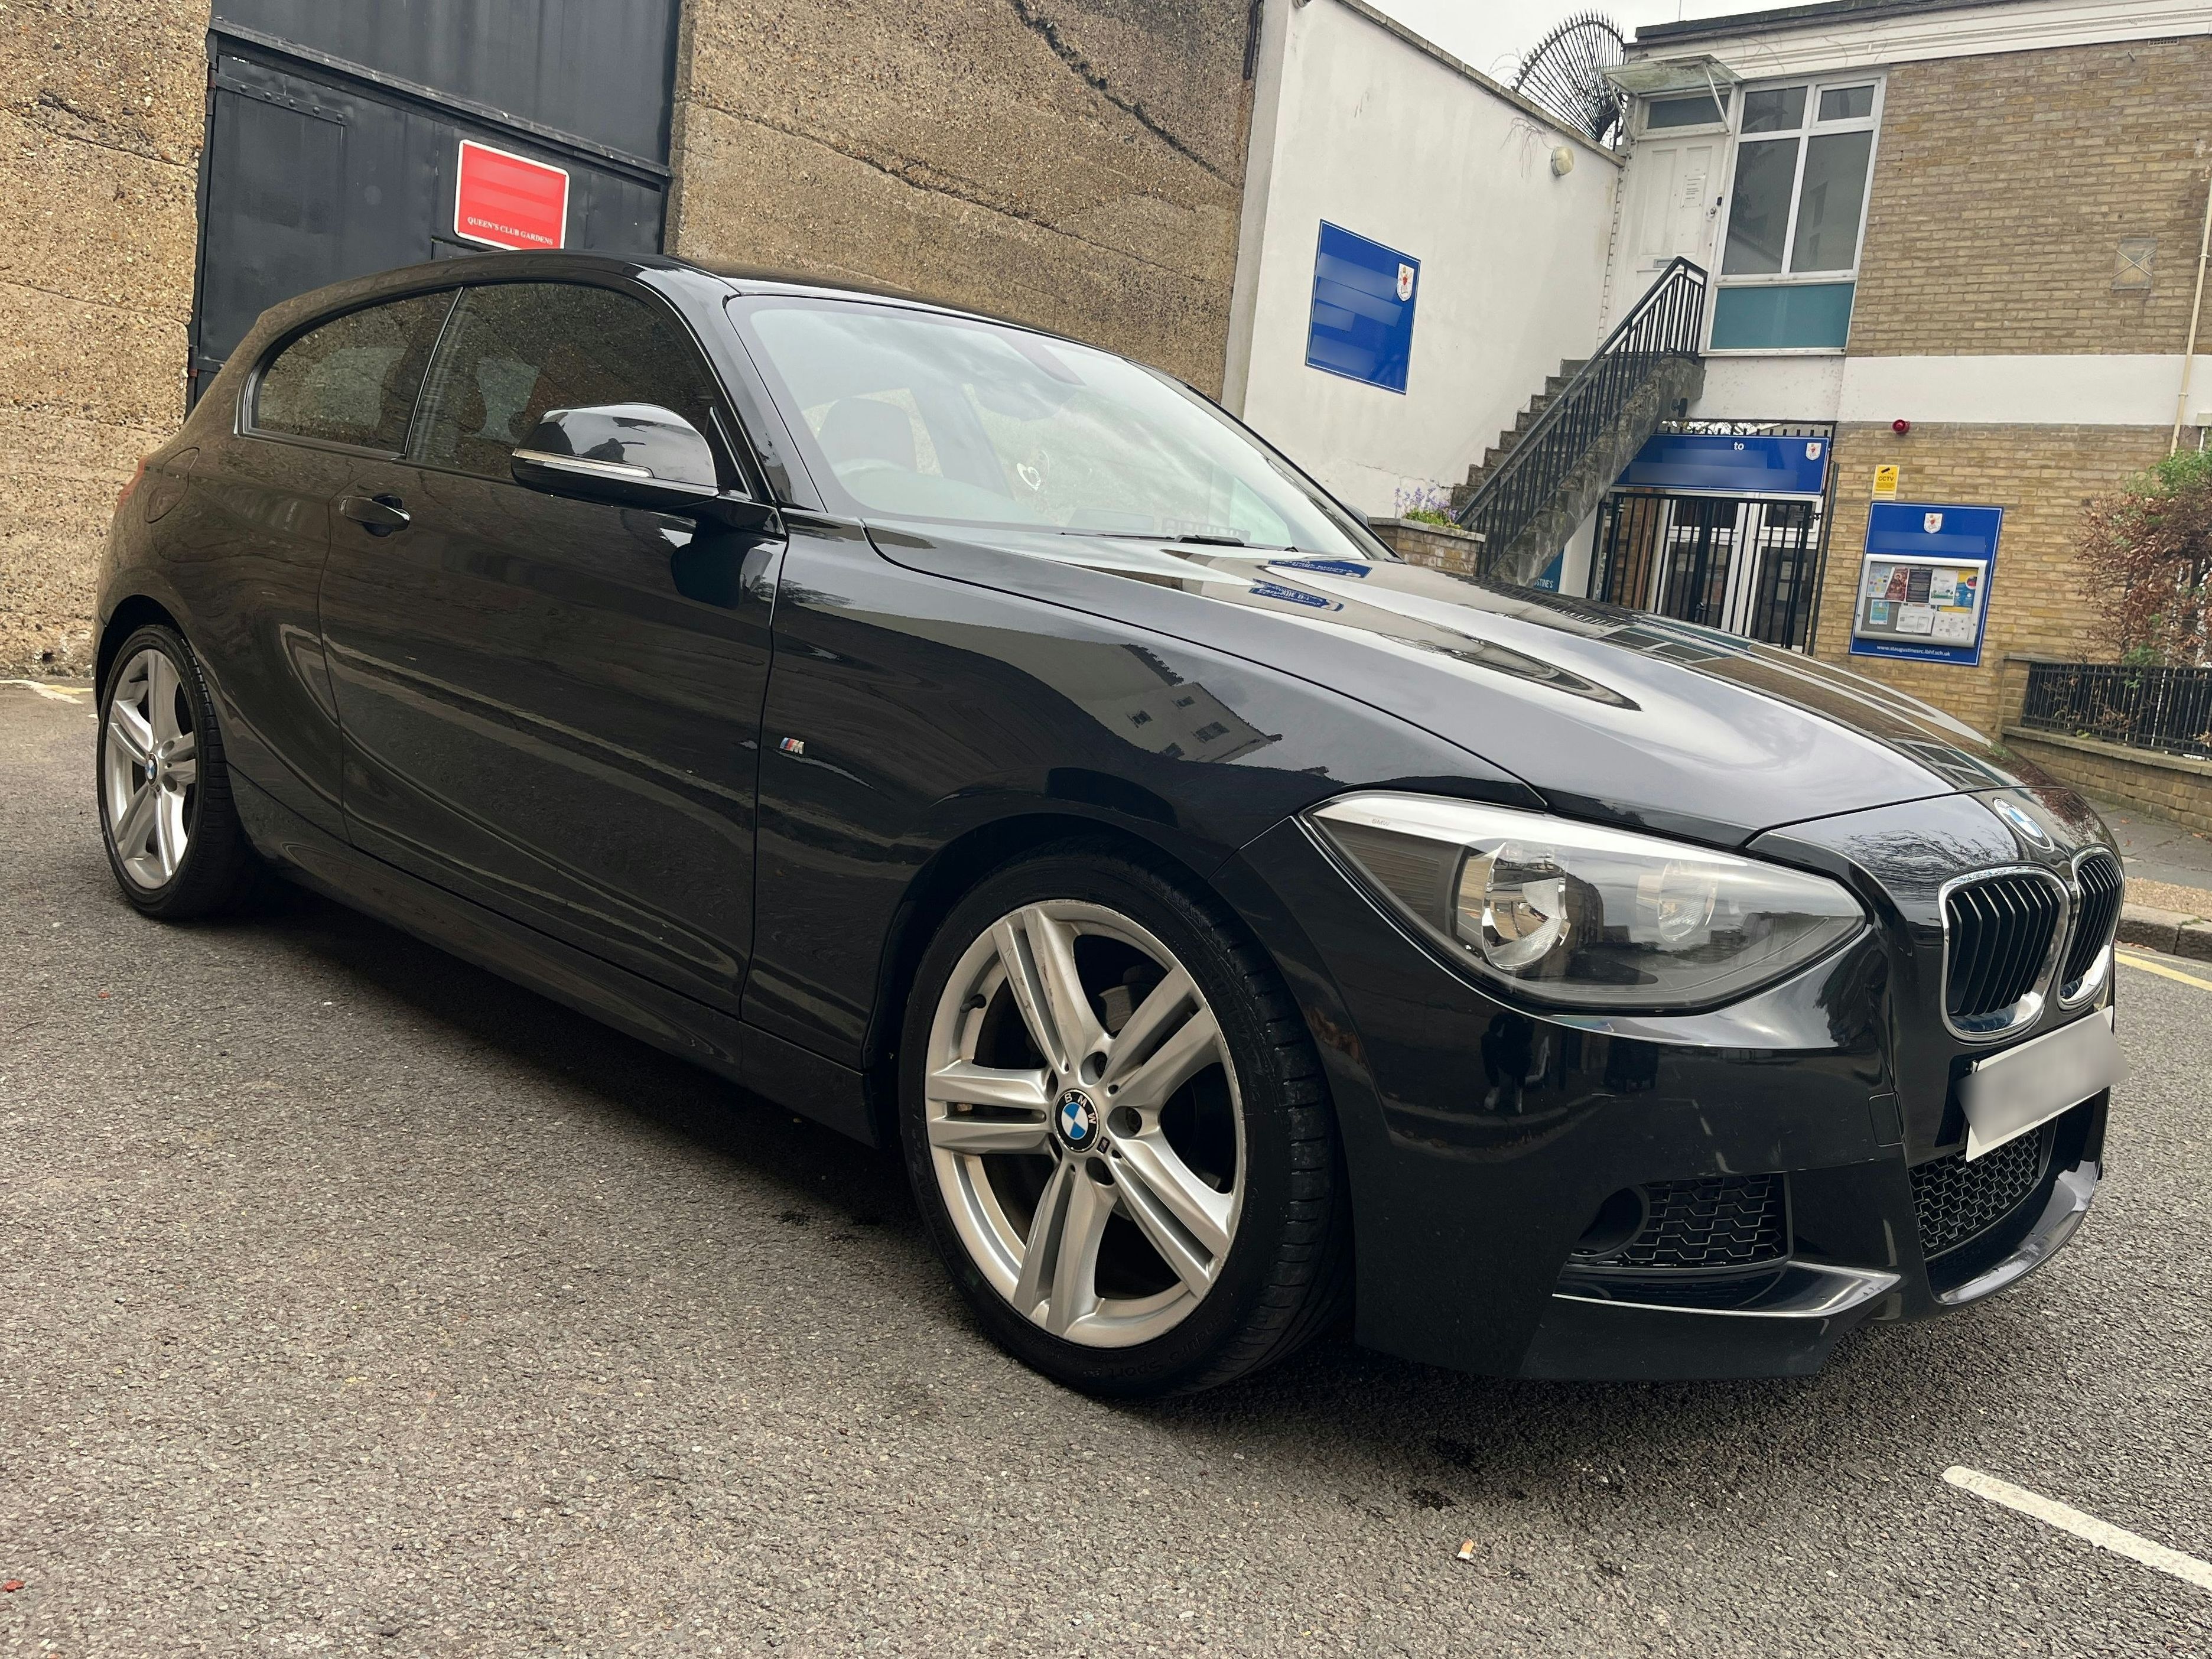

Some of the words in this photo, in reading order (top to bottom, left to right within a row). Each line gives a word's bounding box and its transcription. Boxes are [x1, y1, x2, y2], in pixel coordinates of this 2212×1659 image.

[468, 216, 499, 231] QUEEN'S
[500, 226, 520, 237] CLUB
[521, 231, 553, 245] GARDENS
[1734, 442, 1745, 450] to
[1876, 645, 1951, 656] www.staugustinesrc.lbhf.sch.uk
[1371, 818, 1391, 827] BMW
[1064, 1092, 1097, 1124] BMW
